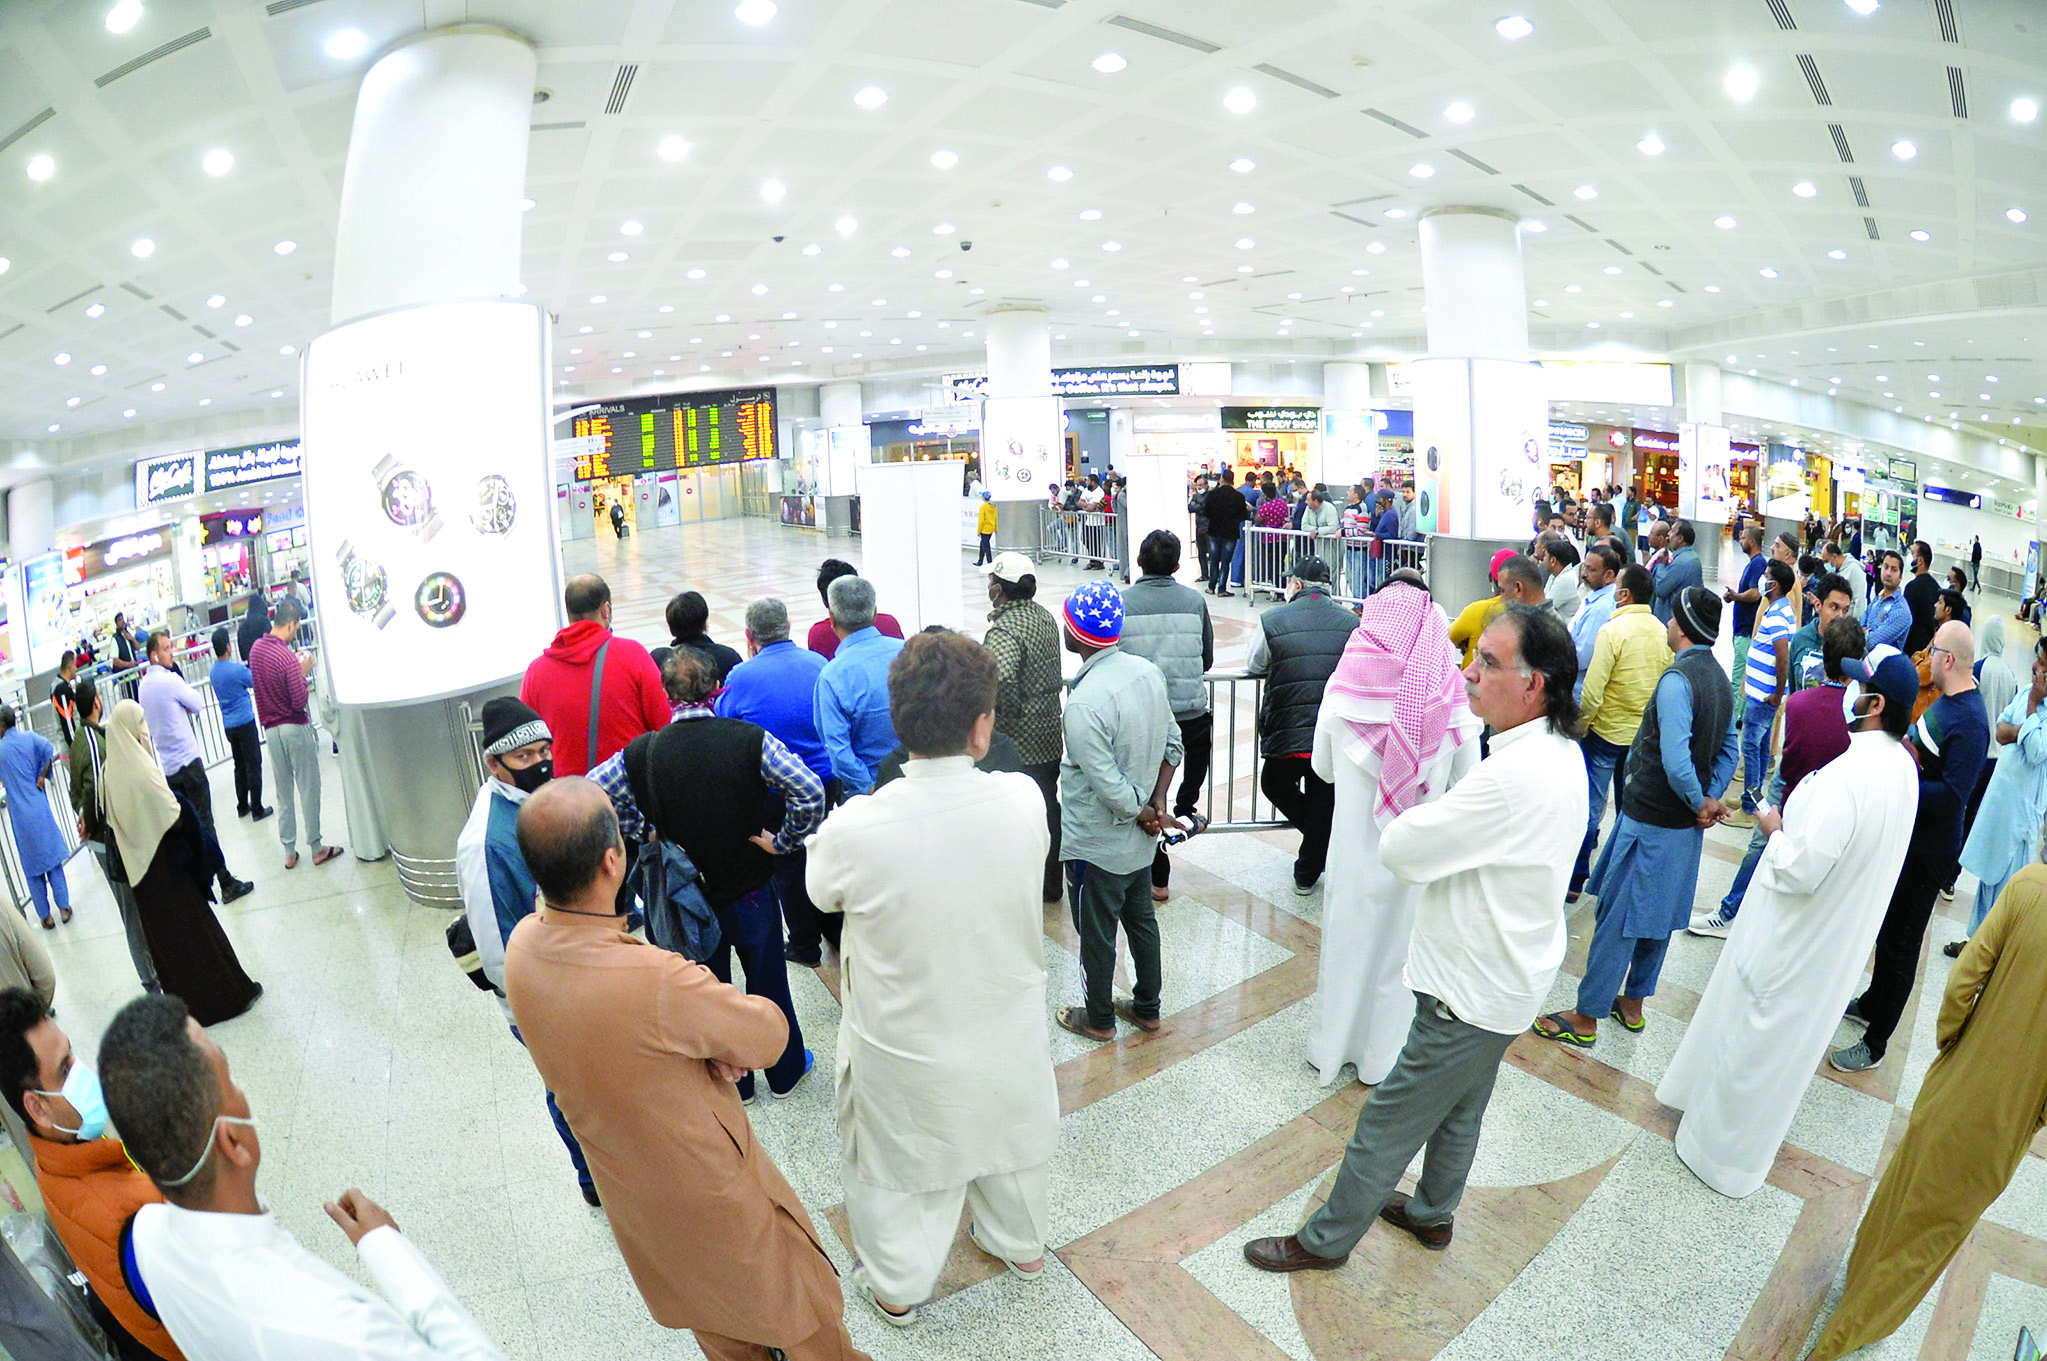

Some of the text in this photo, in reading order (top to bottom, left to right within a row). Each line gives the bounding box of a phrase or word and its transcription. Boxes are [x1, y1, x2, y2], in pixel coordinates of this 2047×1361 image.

[589, 404, 625, 416] ARRIVALS
[1246, 419, 1265, 428] THE
[1265, 419, 1292, 429] BODY
